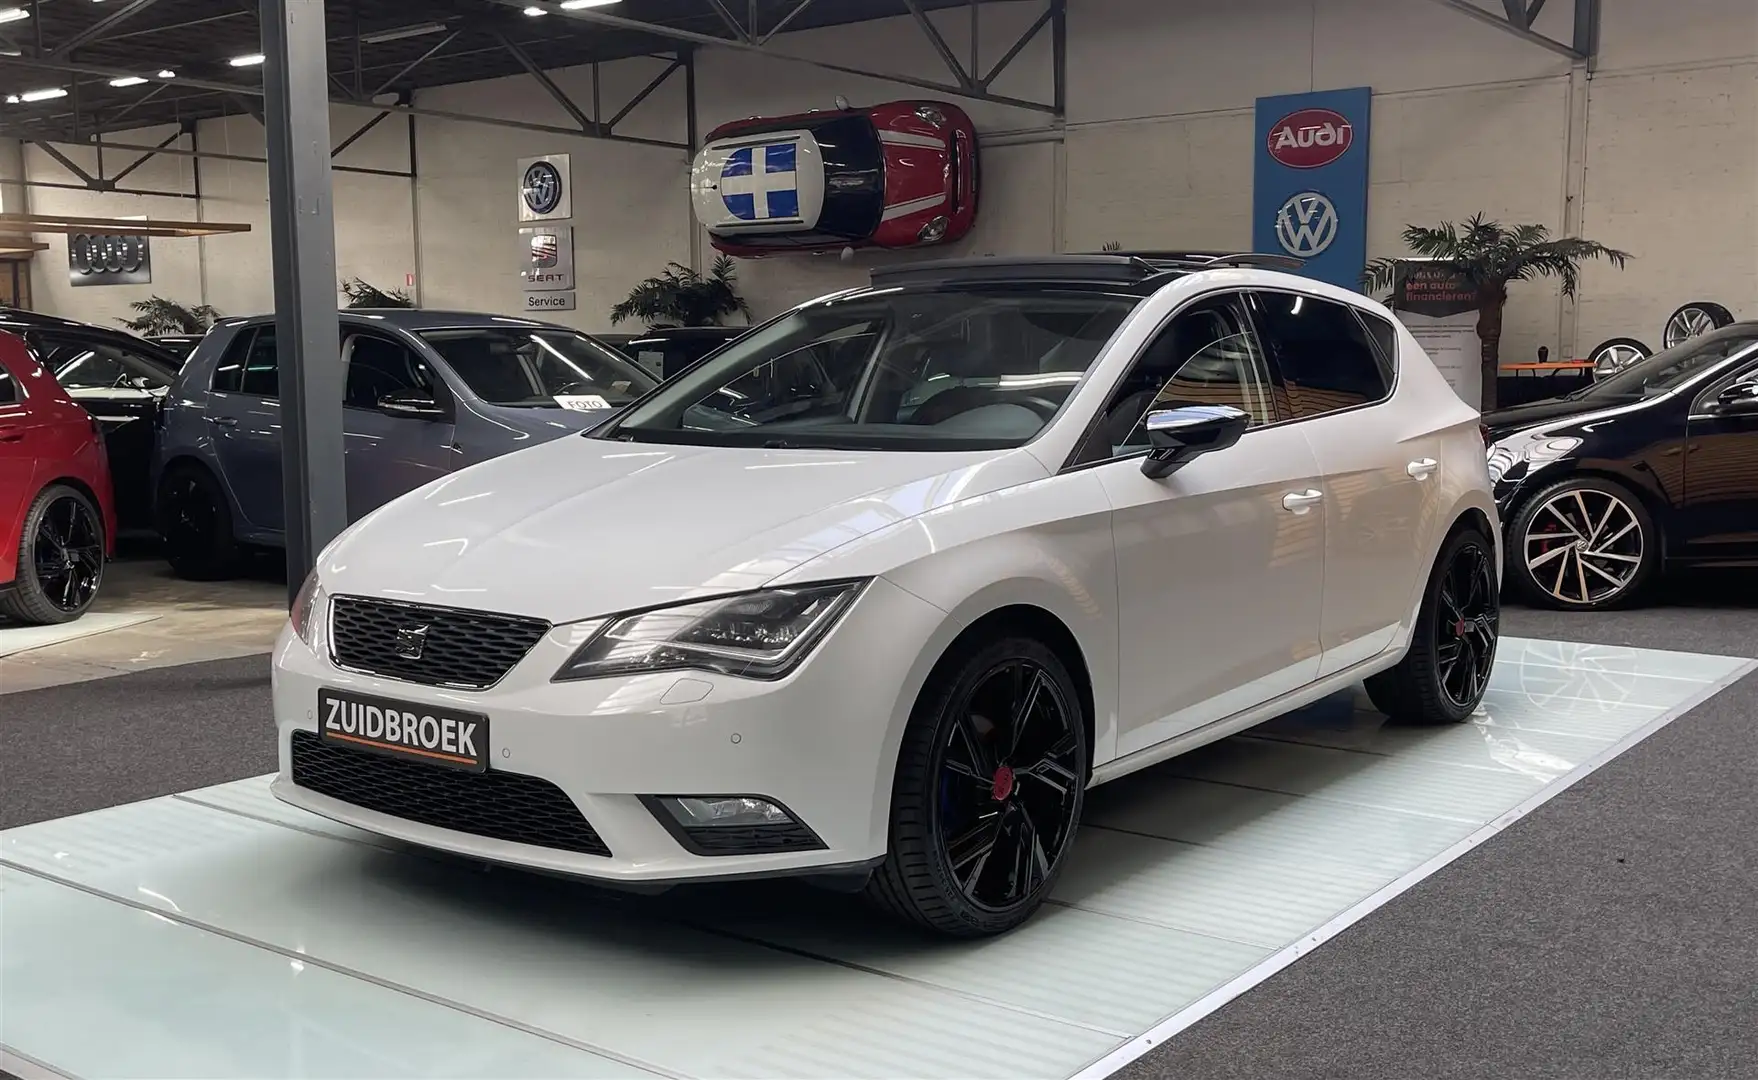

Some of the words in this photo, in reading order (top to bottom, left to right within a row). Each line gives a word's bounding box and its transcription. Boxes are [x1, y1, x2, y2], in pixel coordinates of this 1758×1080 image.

[1274, 122, 1345, 151] Audi
[1277, 192, 1337, 257] VW
[528, 274, 564, 282] SEAT
[528, 296, 565, 306] Service
[568, 400, 602, 409] FOTO
[326, 698, 477, 756] ZUIDBROEK
